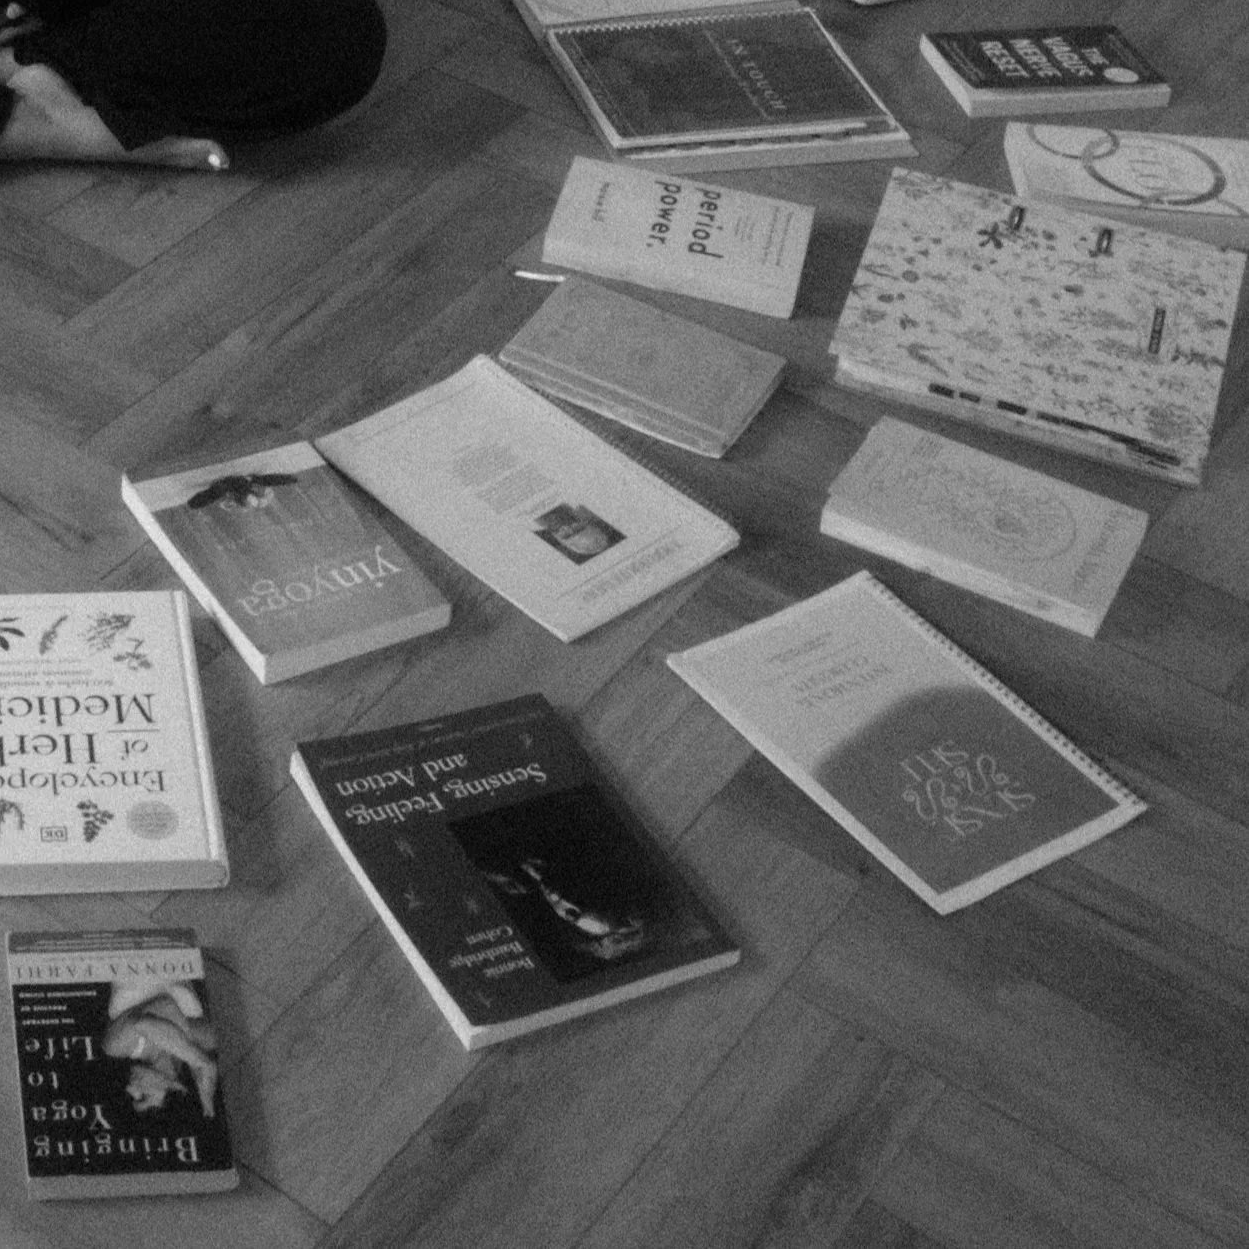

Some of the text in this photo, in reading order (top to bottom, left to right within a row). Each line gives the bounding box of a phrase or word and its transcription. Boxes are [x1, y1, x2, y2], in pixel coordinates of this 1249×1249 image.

[979, 41, 1030, 76] RESET
[1008, 38, 1062, 80] NERVE
[1041, 35, 1095, 76] VAGUS
[726, 37, 747, 55] IN
[741, 60, 787, 111] TOUCH
[640, 178, 684, 252] power.
[679, 185, 737, 260] period
[231, 537, 405, 631] yinyoga
[119, 737, 149, 759] of
[334, 749, 470, 806] and Action
[343, 761, 547, 832] Sensing, Feeling,
[44, 828, 64, 838] DK
[464, 922, 515, 949] Cohen
[14, 960, 194, 978] DONNA FARHI
[446, 936, 524, 972] Bainbridge
[481, 952, 536, 982] Bonnie
[23, 1035, 94, 1062] Life
[26, 1070, 59, 1090] to
[30, 1097, 111, 1132] Yoga
[32, 1129, 201, 1168] Bringing
